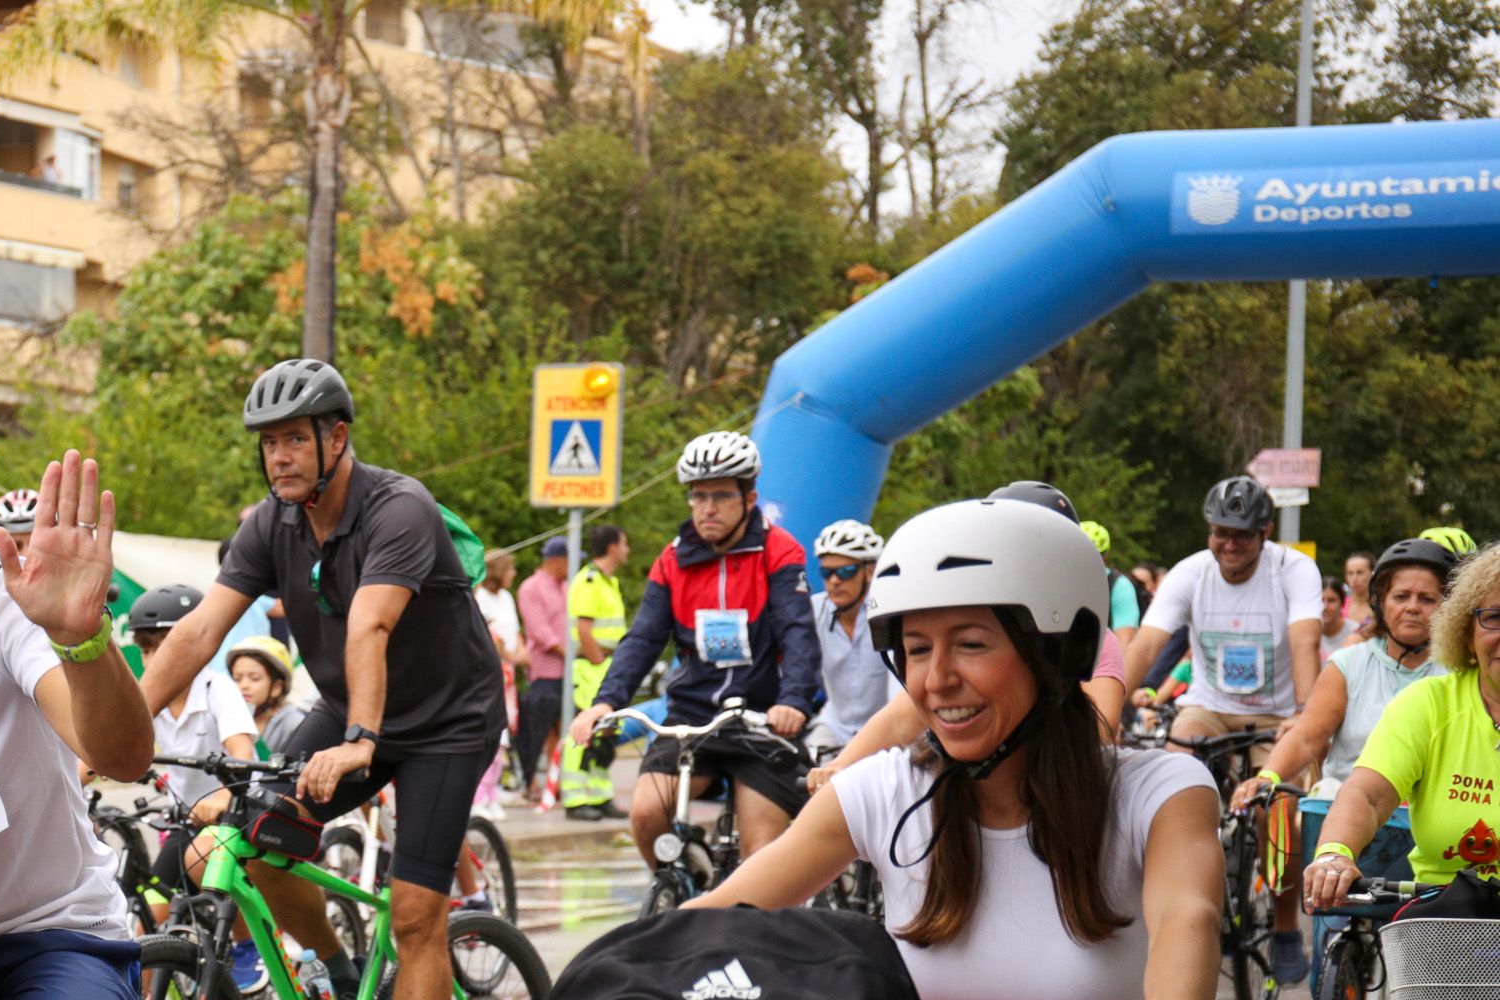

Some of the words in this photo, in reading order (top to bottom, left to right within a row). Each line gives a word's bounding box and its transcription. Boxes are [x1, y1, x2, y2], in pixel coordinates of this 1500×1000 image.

[1253, 202, 1413, 224] Deportes
[543, 482, 605, 499] PEATONES
[1452, 774, 1494, 791] DONA
[1447, 788, 1492, 805] DONA
